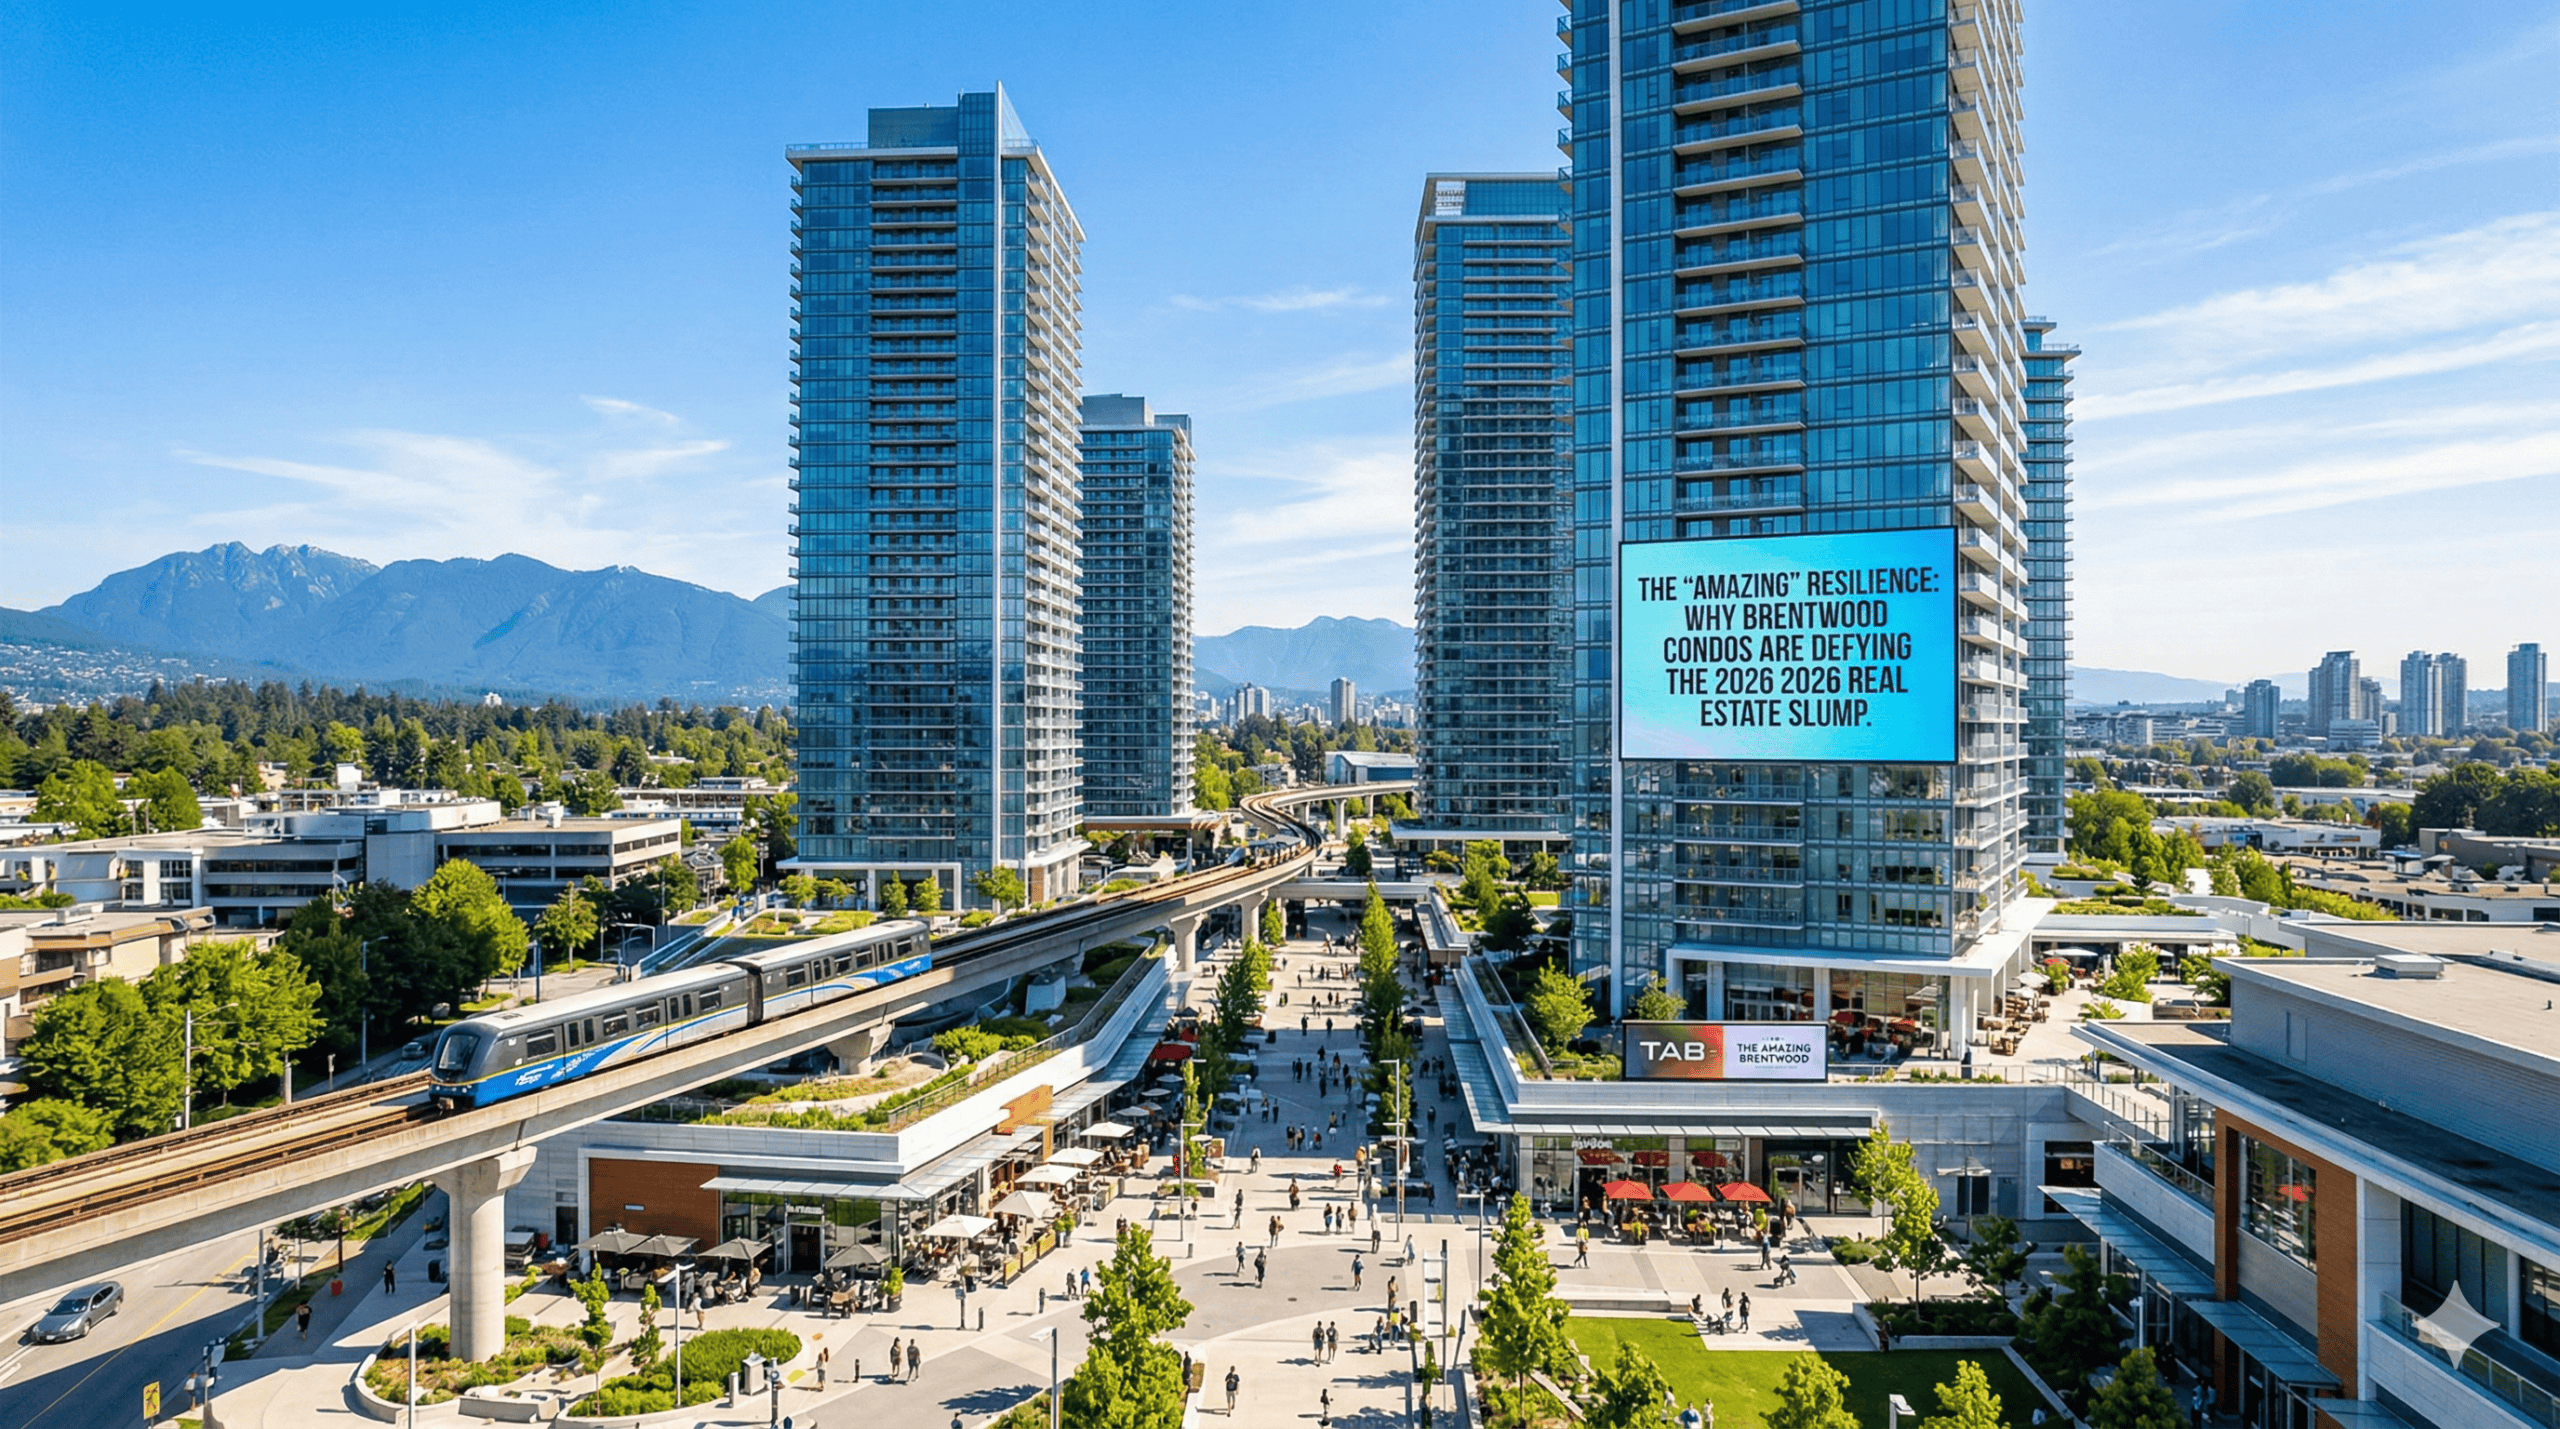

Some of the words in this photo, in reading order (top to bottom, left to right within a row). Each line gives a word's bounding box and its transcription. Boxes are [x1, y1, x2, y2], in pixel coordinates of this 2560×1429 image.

[1638, 576, 1677, 601] THE
[1807, 567, 1939, 595] RESILIENCE:
[1685, 604, 1736, 631] WHY
[1743, 600, 1888, 630] BRENTWOOD
[1664, 635, 1752, 663] CONDOS
[1759, 634, 1804, 662] ARE
[1811, 632, 1912, 660] DEFYING
[1666, 668, 1708, 695] THE
[1715, 667, 1773, 694] 2026
[1781, 667, 1841, 694] 2026
[1848, 665, 1909, 693] REAL
[1701, 699, 1781, 726] ESTATE
[1789, 699, 1872, 726] SLUMP.
[1639, 1041, 1705, 1061] TAB
[1737, 1043, 1758, 1053] THE
[1761, 1043, 1811, 1053] AMAZING
[1739, 1054, 1810, 1064] BRENTWOOD
